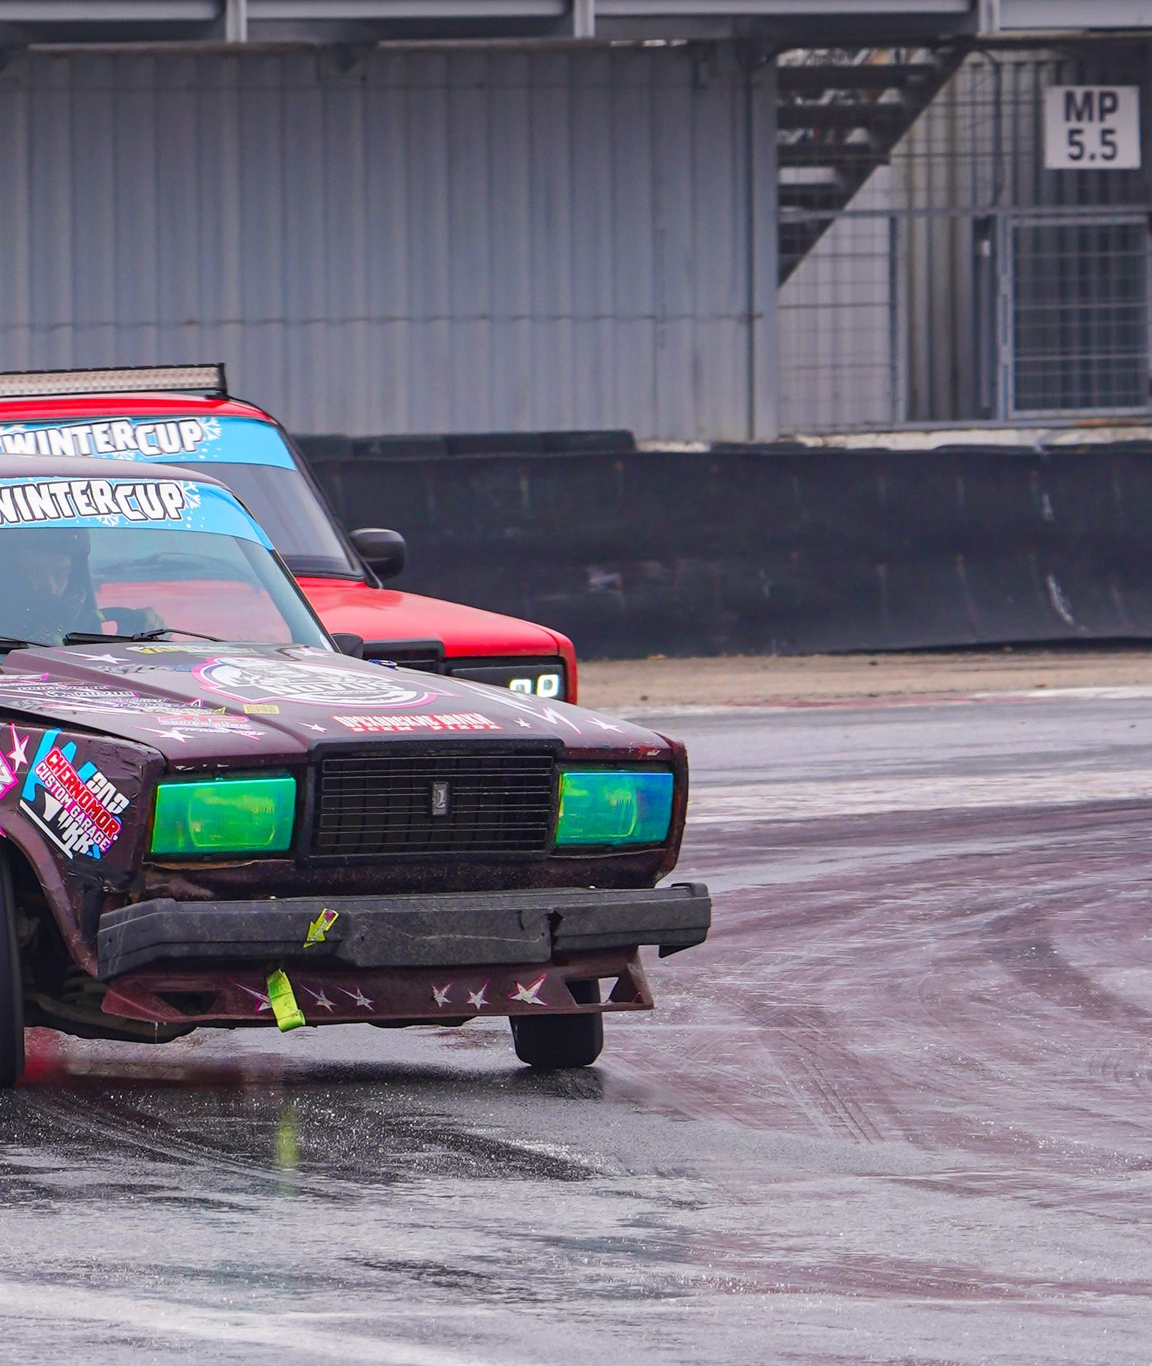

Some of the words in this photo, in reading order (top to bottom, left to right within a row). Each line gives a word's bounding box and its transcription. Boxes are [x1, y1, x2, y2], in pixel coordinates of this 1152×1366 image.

[1064, 88, 1120, 123] MP
[1067, 128, 1119, 162] 5.5
[35, 762, 72, 808] CUSTOM
[69, 805, 112, 852] GARAGE
